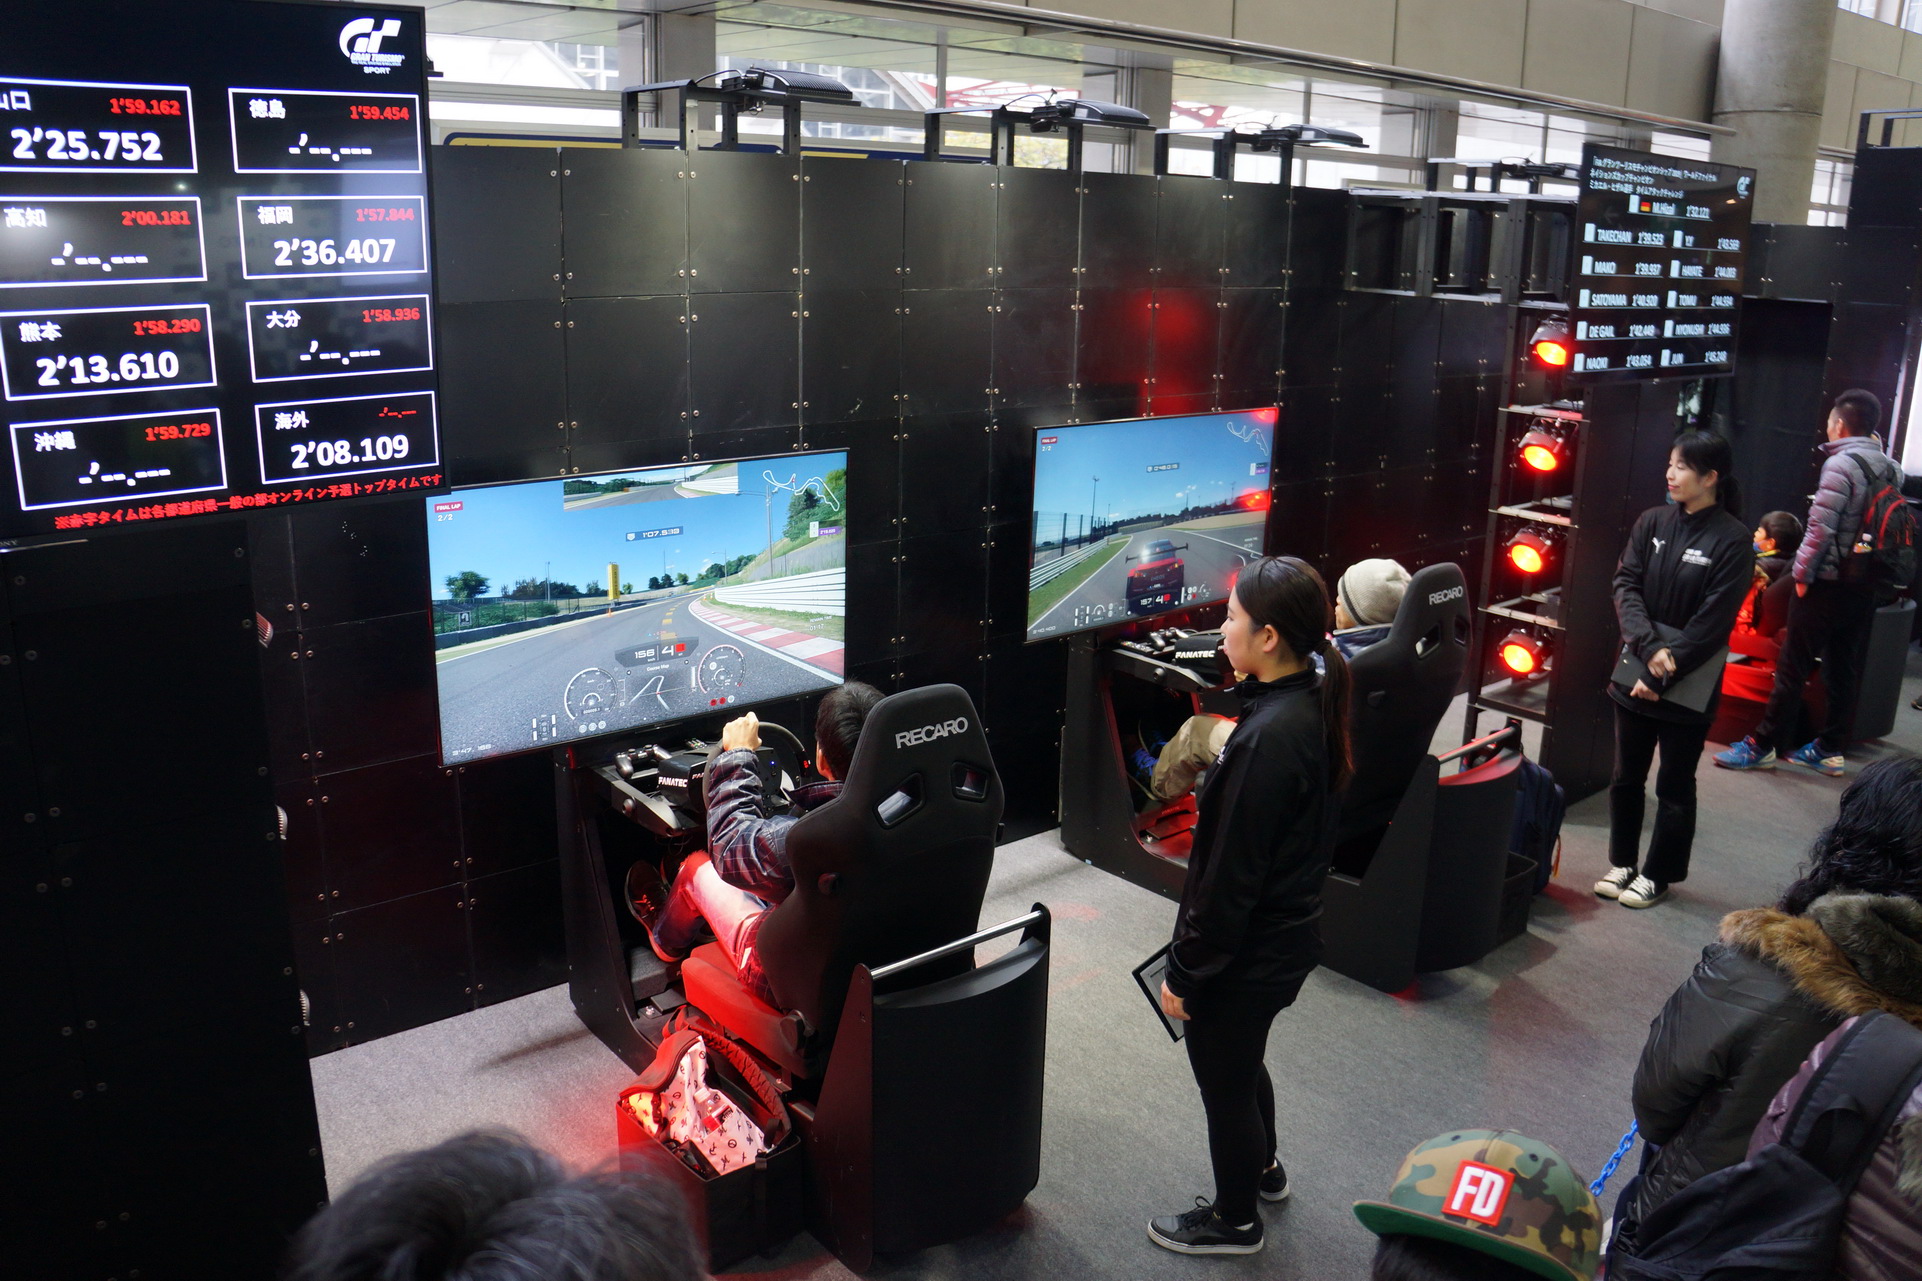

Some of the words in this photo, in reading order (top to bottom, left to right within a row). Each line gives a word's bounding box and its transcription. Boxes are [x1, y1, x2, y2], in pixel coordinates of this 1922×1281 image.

[363, 66, 391, 74] SPORT
[350, 104, 410, 121] 1'59.454
[11, 126, 164, 162] 2'25.752
[3, 207, 48, 228] 高知
[121, 210, 192, 227] 2'00.181
[257, 206, 294, 225] 福岡
[273, 238, 397, 267] 2'36.407
[265, 309, 302, 329] 大分
[362, 307, 421, 323] 1'58.936
[18, 321, 63, 343] 熊本
[133, 318, 202, 336] 1'58.290
[36, 351, 180, 387] 2'13.610
[274, 410, 310, 430] 海外
[34, 430, 77, 452] 沖縄
[144, 423, 212, 441] 1'59.729
[290, 434, 409, 469] 2'08.109
[437, 513, 454, 522] 2/2
[1428, 585, 1464, 606] RECARO
[661, 644, 675, 656] 4
[1175, 650, 1216, 659] FANATEC
[894, 716, 969, 750] RECARO
[658, 776, 689, 788] FANATEC
[1450, 1165, 1506, 1218] FD
